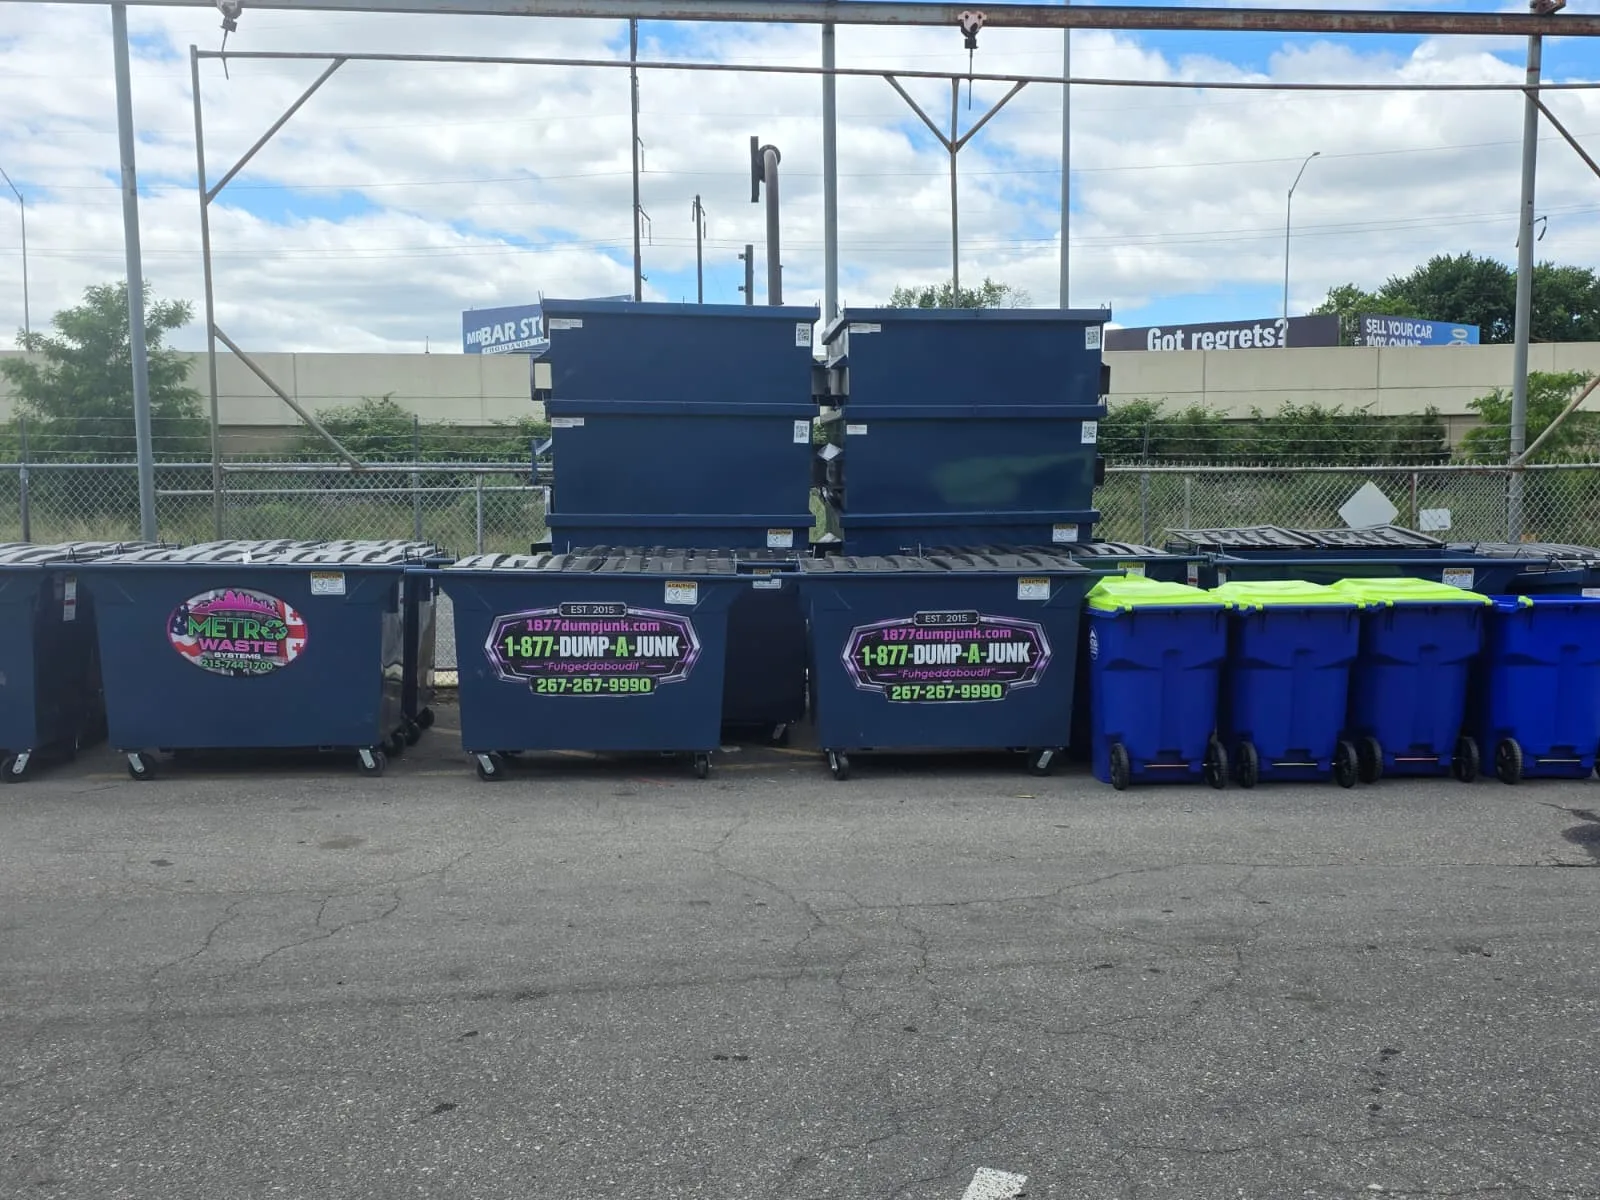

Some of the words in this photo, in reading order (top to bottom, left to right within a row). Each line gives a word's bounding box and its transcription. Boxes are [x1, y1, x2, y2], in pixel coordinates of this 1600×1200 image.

[480, 321, 516, 346] BAR
[1147, 327, 1185, 350] Got
[1191, 318, 1289, 350] regrets?
[1366, 318, 1387, 334] SELL
[1387, 321, 1413, 337] YOUR
[1414, 323, 1433, 339] CAR
[1366, 335, 1387, 347] 100%
[592, 605, 615, 614] 2015
[946, 613, 968, 623] 2015
[526, 619, 660, 634] 1877dumpjunk.com
[882, 628, 1012, 642] 1877dumpjunk.com
[198, 638, 278, 653] WASTE
[504, 635, 680, 658] 1-877-DUMP-A-JUNK
[214, 652, 261, 660] SYSTEMS
[862, 642, 1031, 666] 1-877-DUMP-A-JUNK
[201, 659, 273, 670] 215-744-1700
[536, 677, 652, 693] 267-267-9990
[891, 684, 1002, 700] 267-267-9990
